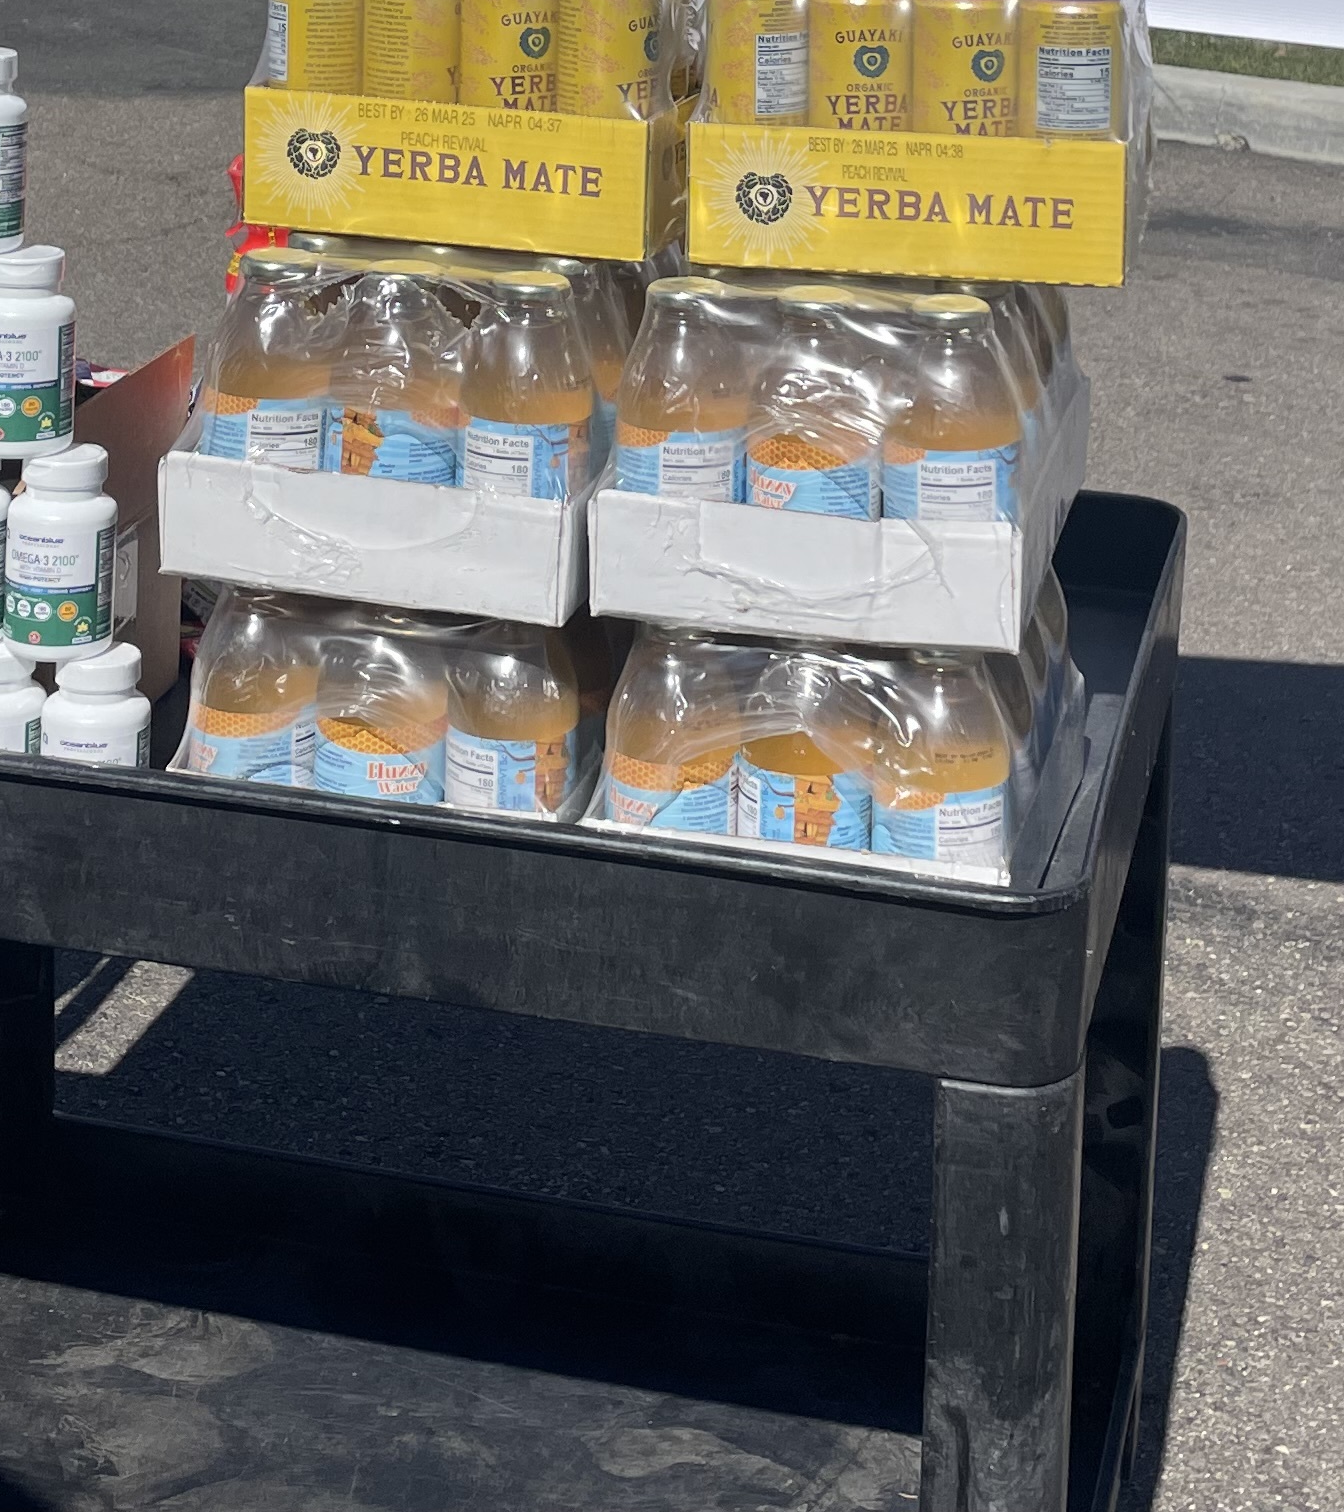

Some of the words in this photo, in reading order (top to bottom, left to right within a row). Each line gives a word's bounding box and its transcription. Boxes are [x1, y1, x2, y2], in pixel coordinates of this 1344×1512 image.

[1039, 46, 1083, 57] Nutrition
[1085, 48, 1110, 56] Facts
[1039, 69, 1074, 79] Calories
[1099, 68, 1110, 78] 15
[489, 73, 557, 96] YERB
[846, 83, 894, 93] ORGANIC
[358, 103, 387, 119] BEST
[390, 104, 405, 121] BY
[414, 107, 430, 124] 26
[432, 107, 458, 126] MAR
[461, 110, 477, 127] 25
[487, 112, 523, 131] NAPR
[527, 116, 563, 134] 04:37
[400, 131, 439, 149] PEACH
[442, 133, 489, 154] REVIVAL
[808, 137, 831, 153] BEST
[833, 138, 846, 154] BY
[851, 139, 863, 155] 26
[864, 140, 885, 156] MAR
[886, 141, 898, 157] 25
[905, 142, 933, 158] NAPR
[935, 143, 964, 159] 04:38
[352, 144, 489, 188] YERBA
[502, 158, 604, 198] MATE
[842, 164, 871, 181] PEACH
[872, 166, 909, 182] REVIVAL
[806, 185, 952, 224] YERBA
[966, 192, 1074, 230] MATE
[251, 413, 294, 423] Nutrition
[296, 413, 319, 422] Facts
[304, 437, 318, 447] 180
[467, 430, 500, 446] Nutrition
[502, 437, 530, 449] Facts
[663, 446, 706, 457] Nutrition
[511, 464, 529, 475] 180
[920, 463, 964, 475] Nutrition
[966, 464, 993, 474] Facts
[920, 492, 951, 501] Calories
[477, 777, 494, 788] 180
[938, 807, 981, 818] Nutrition
